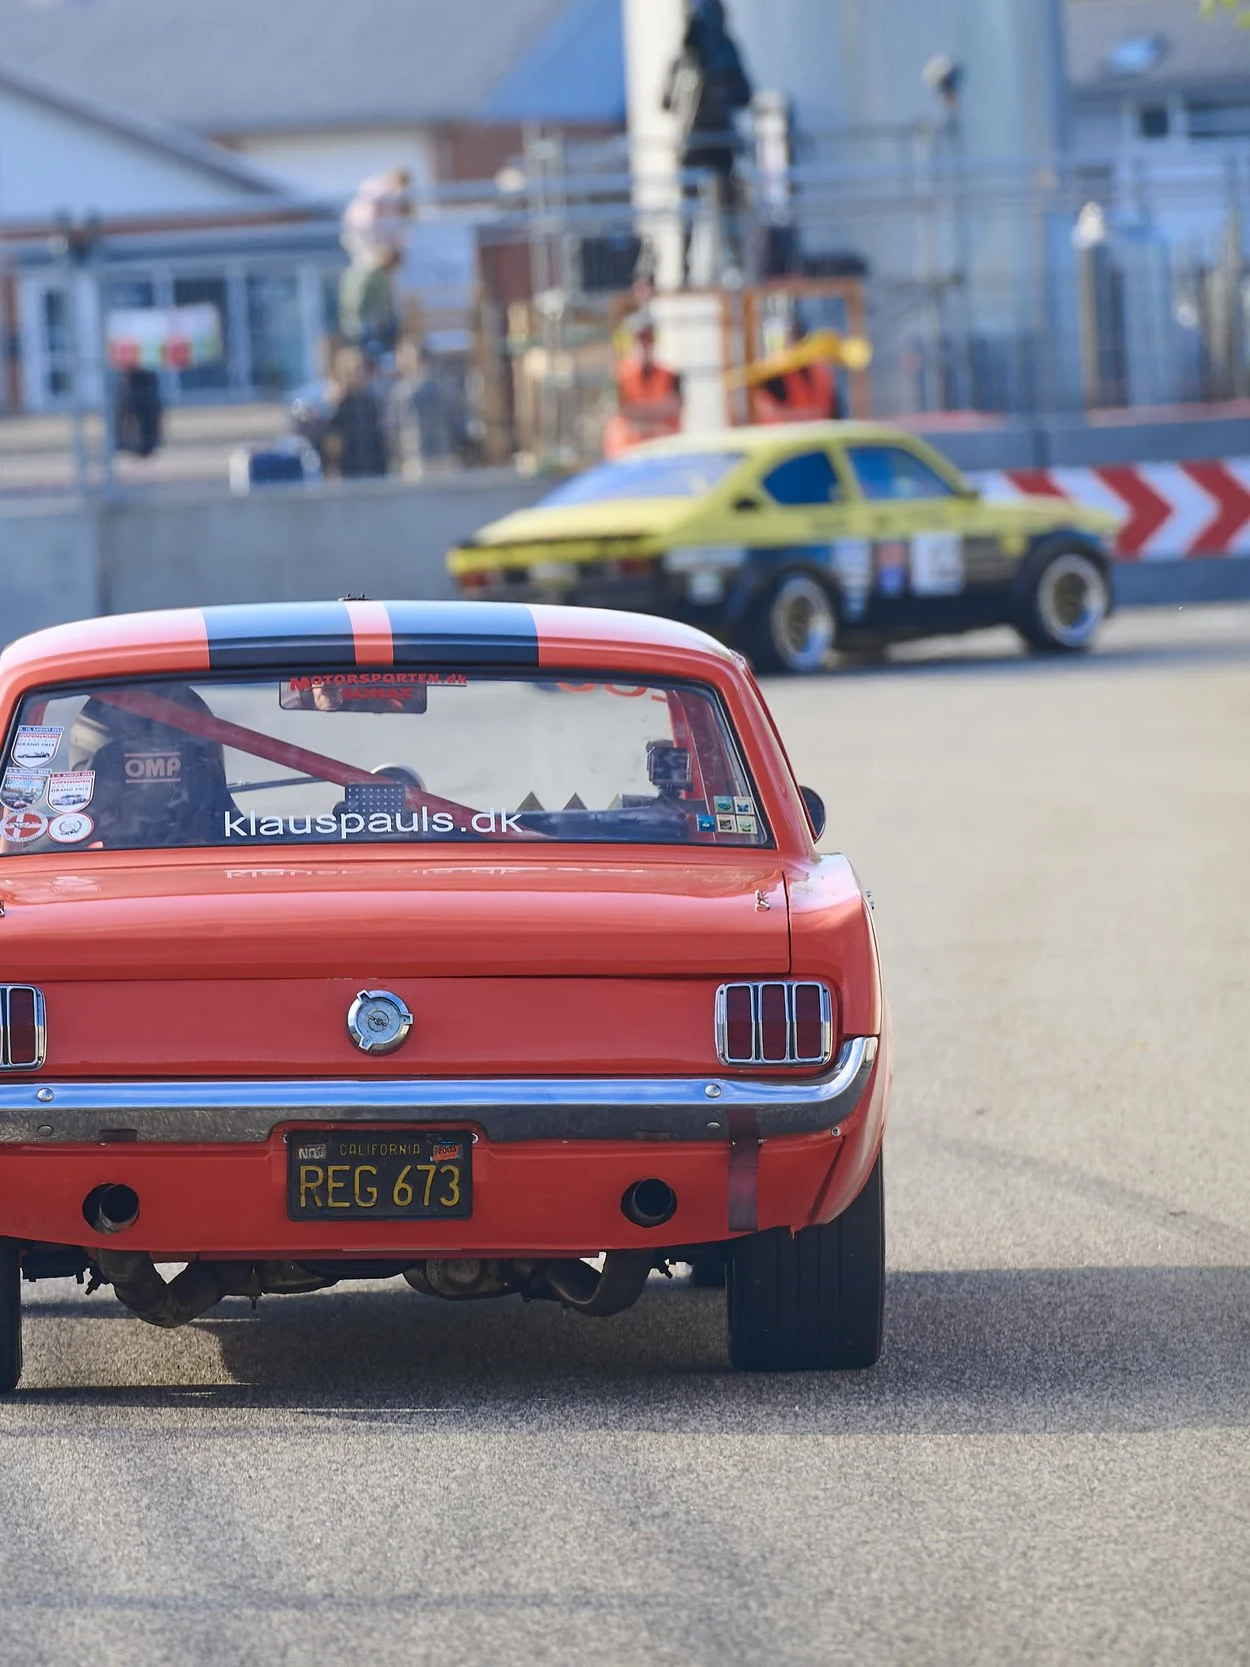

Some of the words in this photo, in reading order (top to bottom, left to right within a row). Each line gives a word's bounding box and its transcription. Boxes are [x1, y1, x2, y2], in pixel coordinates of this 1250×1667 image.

[125, 757, 181, 778] OMP
[224, 806, 523, 839] klauspauls.dk
[339, 1143, 421, 1157] CALIFORNIA
[300, 1165, 378, 1208] REG
[392, 1165, 461, 1207] 673
